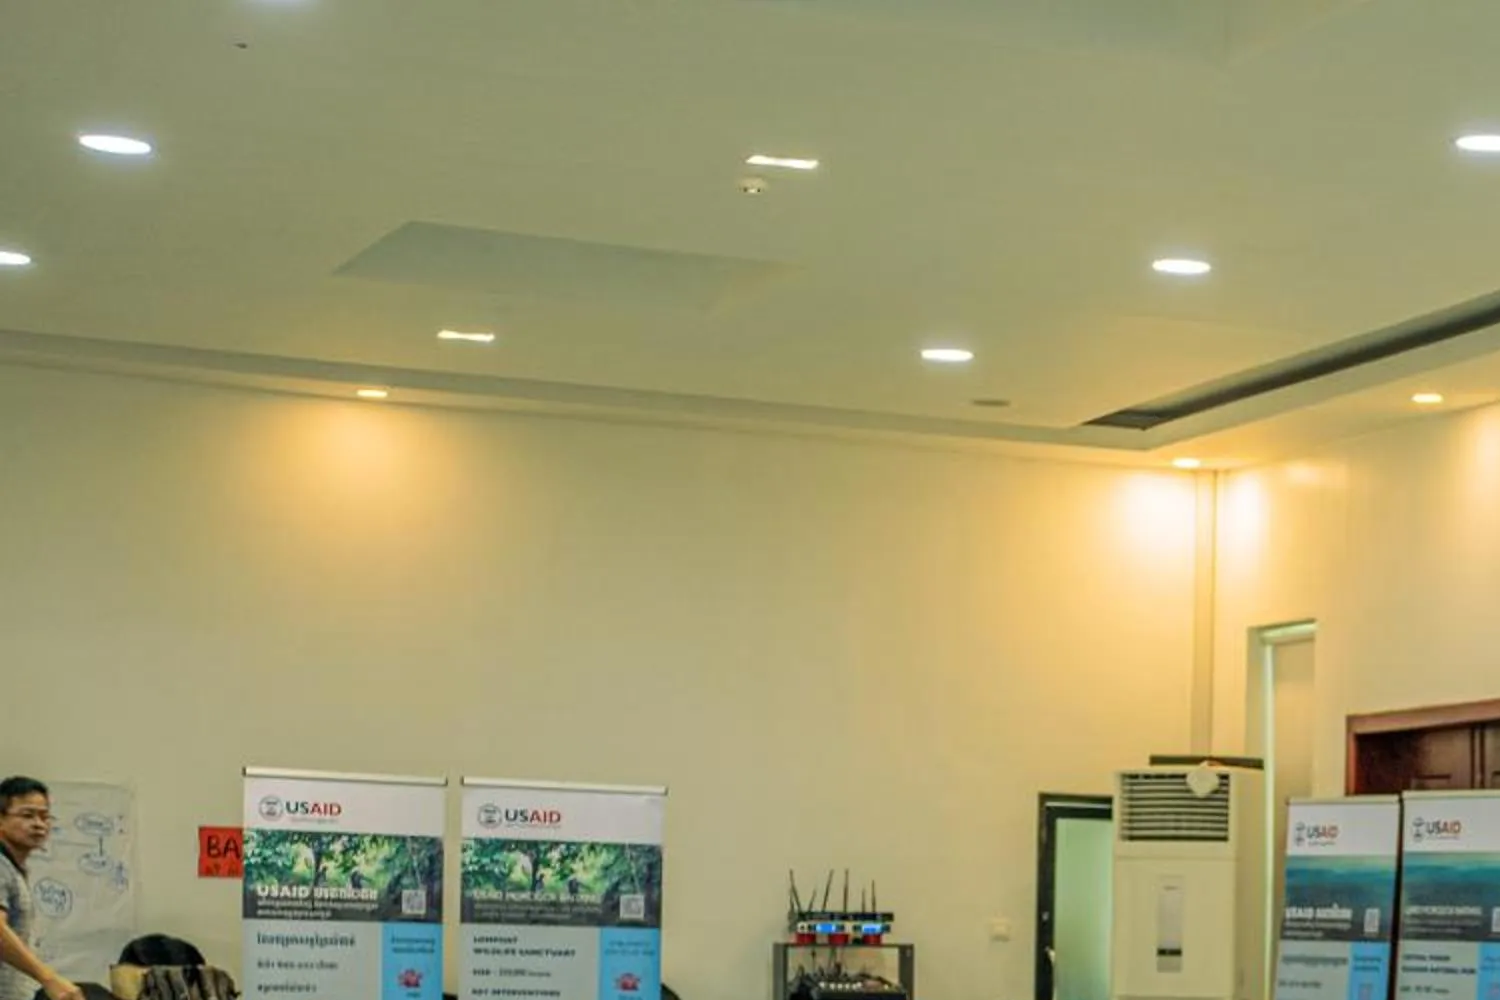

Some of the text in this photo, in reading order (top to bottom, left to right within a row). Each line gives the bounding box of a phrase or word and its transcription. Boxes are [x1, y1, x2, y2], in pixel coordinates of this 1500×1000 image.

[285, 801, 342, 816] USAID
[505, 808, 561, 824] USAID
[1306, 825, 1339, 838] USAID
[1426, 820, 1462, 834] USAID
[256, 885, 309, 898] USAID
